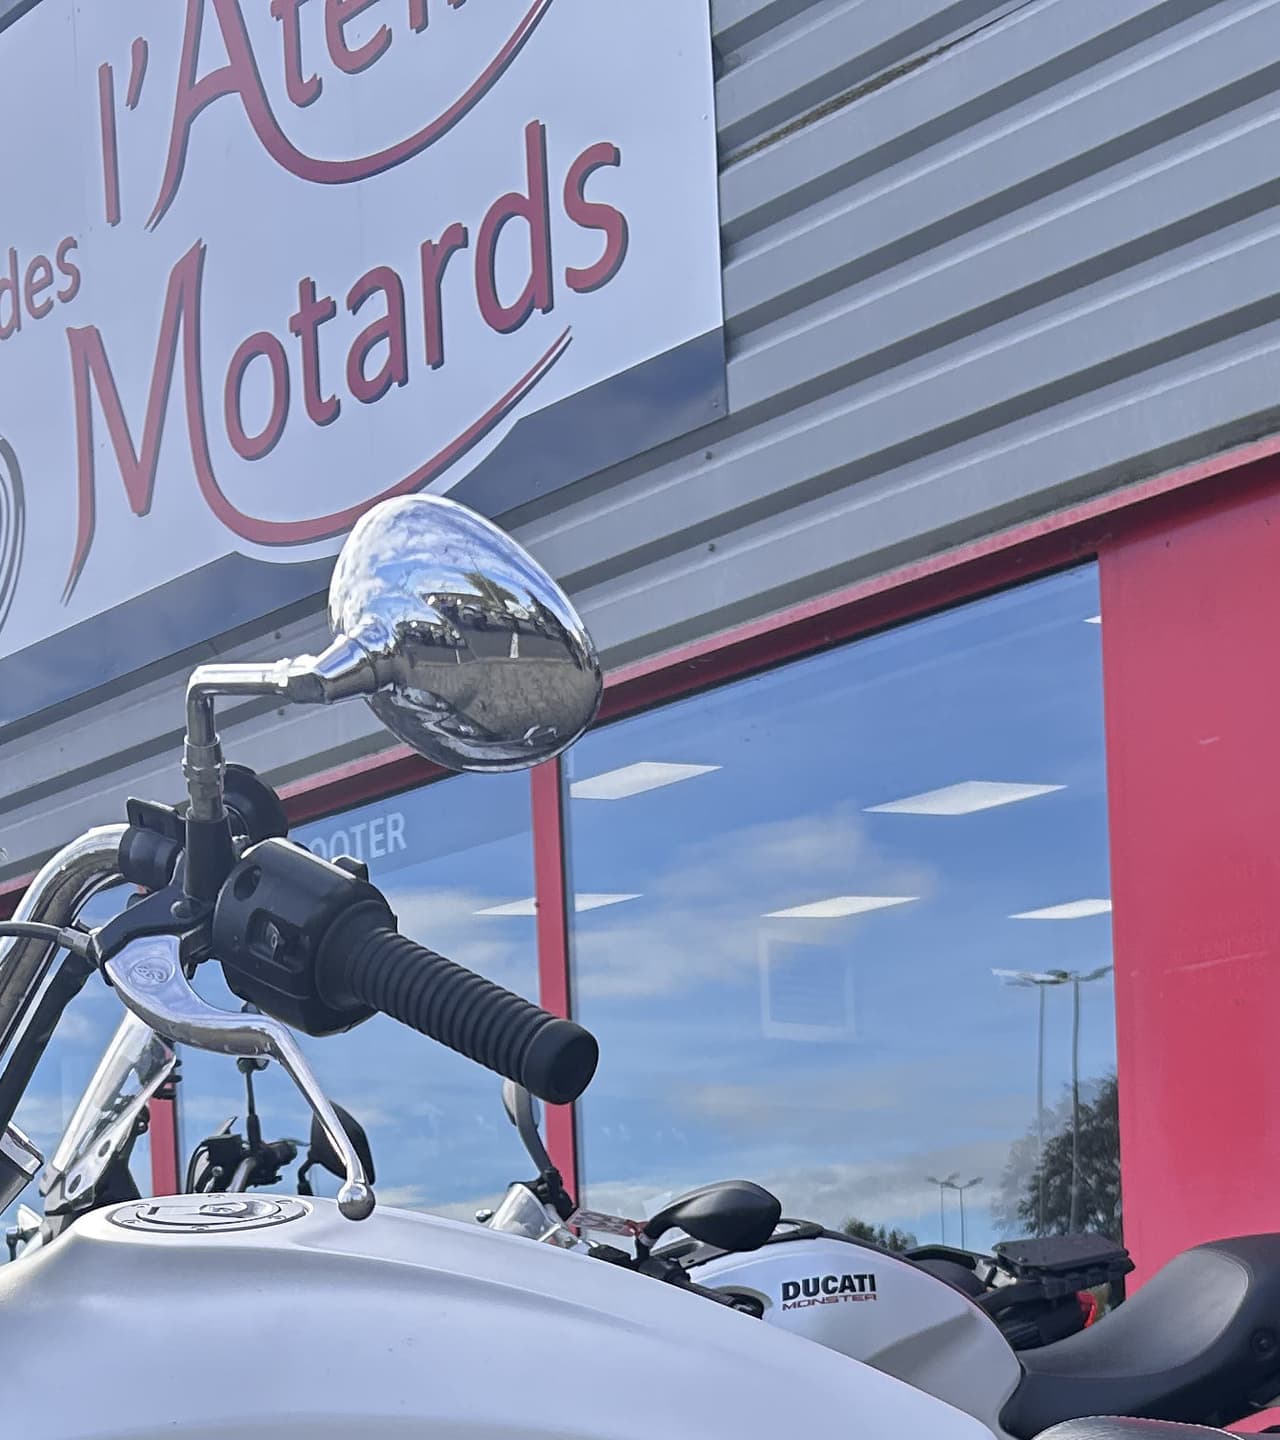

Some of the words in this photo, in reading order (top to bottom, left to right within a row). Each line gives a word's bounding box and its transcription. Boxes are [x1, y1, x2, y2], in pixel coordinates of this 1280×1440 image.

[60, 119, 629, 606] Motards
[781, 1273, 877, 1302] DUCATI
[781, 1294, 878, 1312] MONSTER
